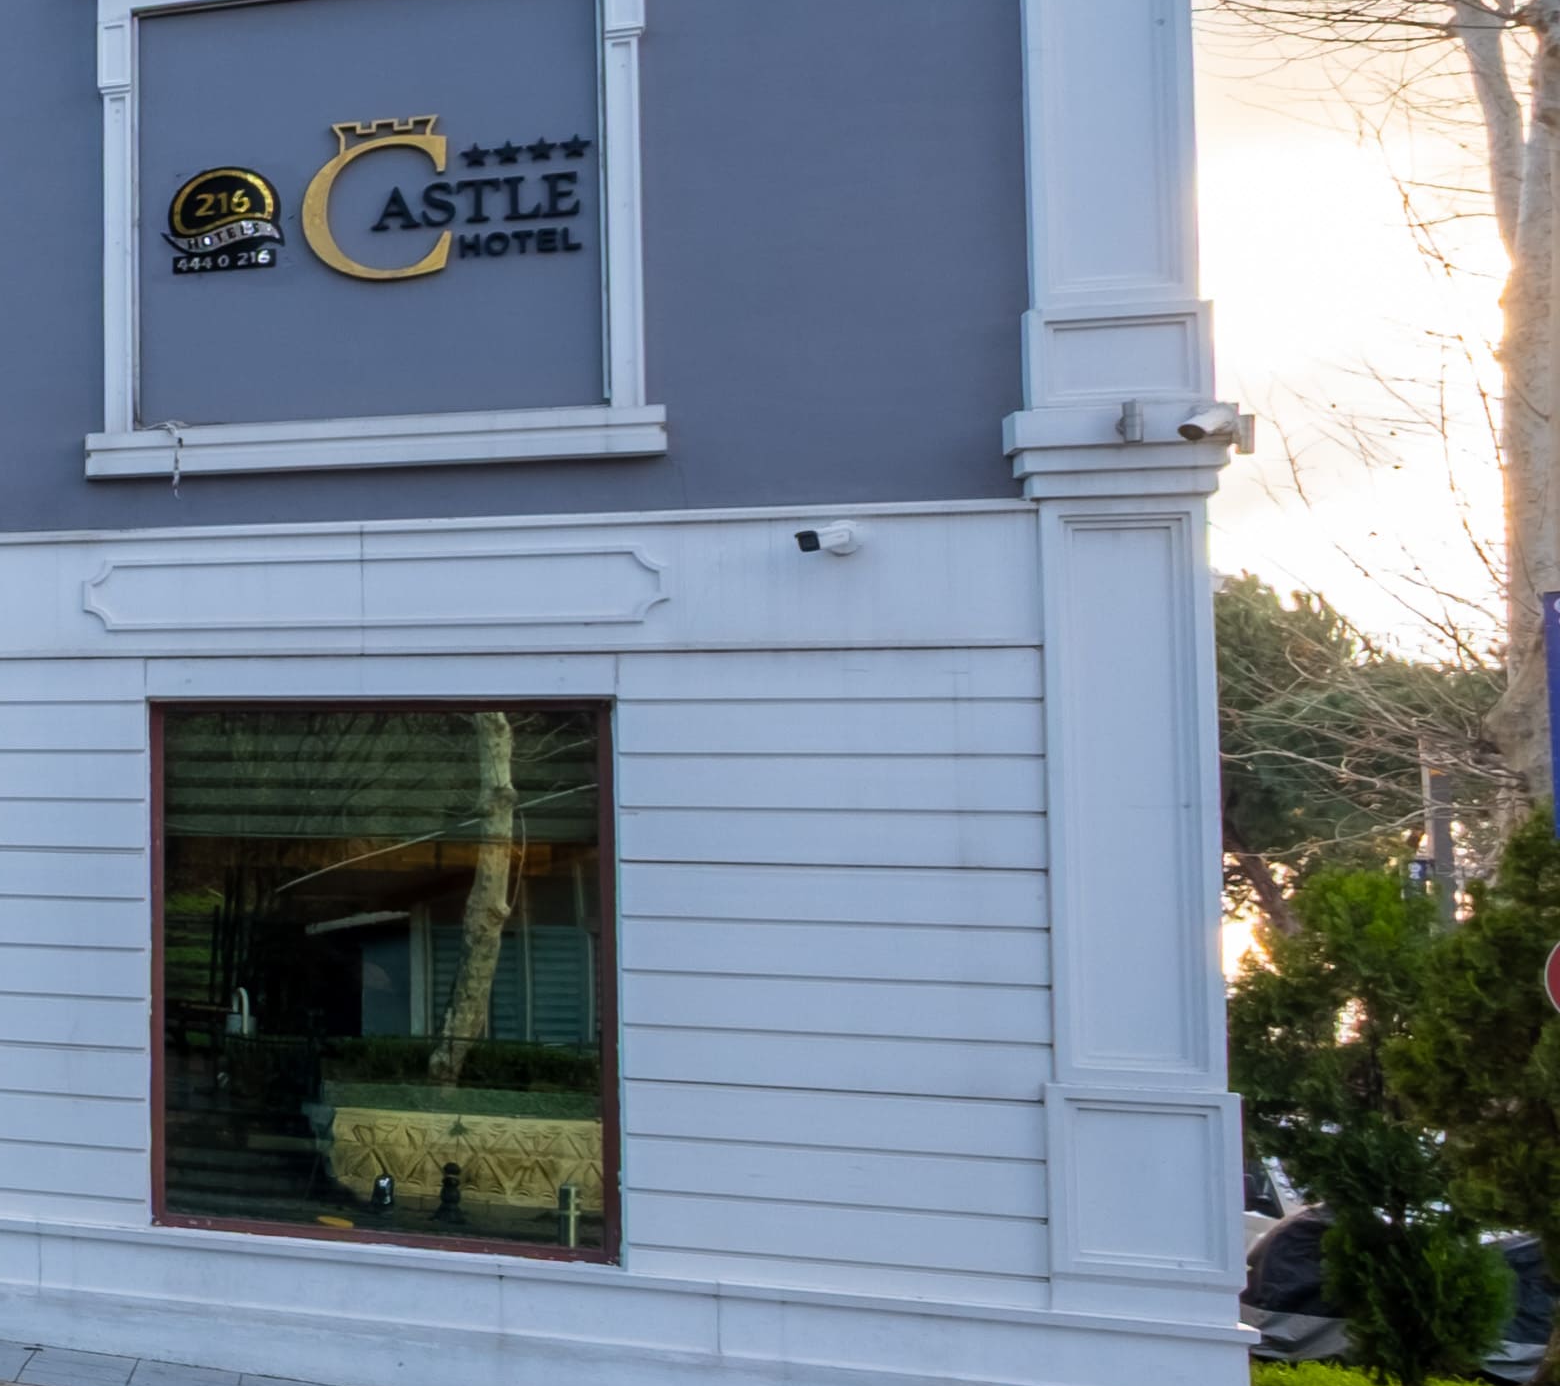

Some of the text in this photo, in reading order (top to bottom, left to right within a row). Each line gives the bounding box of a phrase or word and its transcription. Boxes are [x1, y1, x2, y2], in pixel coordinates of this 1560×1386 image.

[195, 189, 251, 217] 216
[188, 221, 260, 250] HOTELS
[459, 226, 582, 258] HOTEL
[177, 249, 271, 272] 444 0 216
